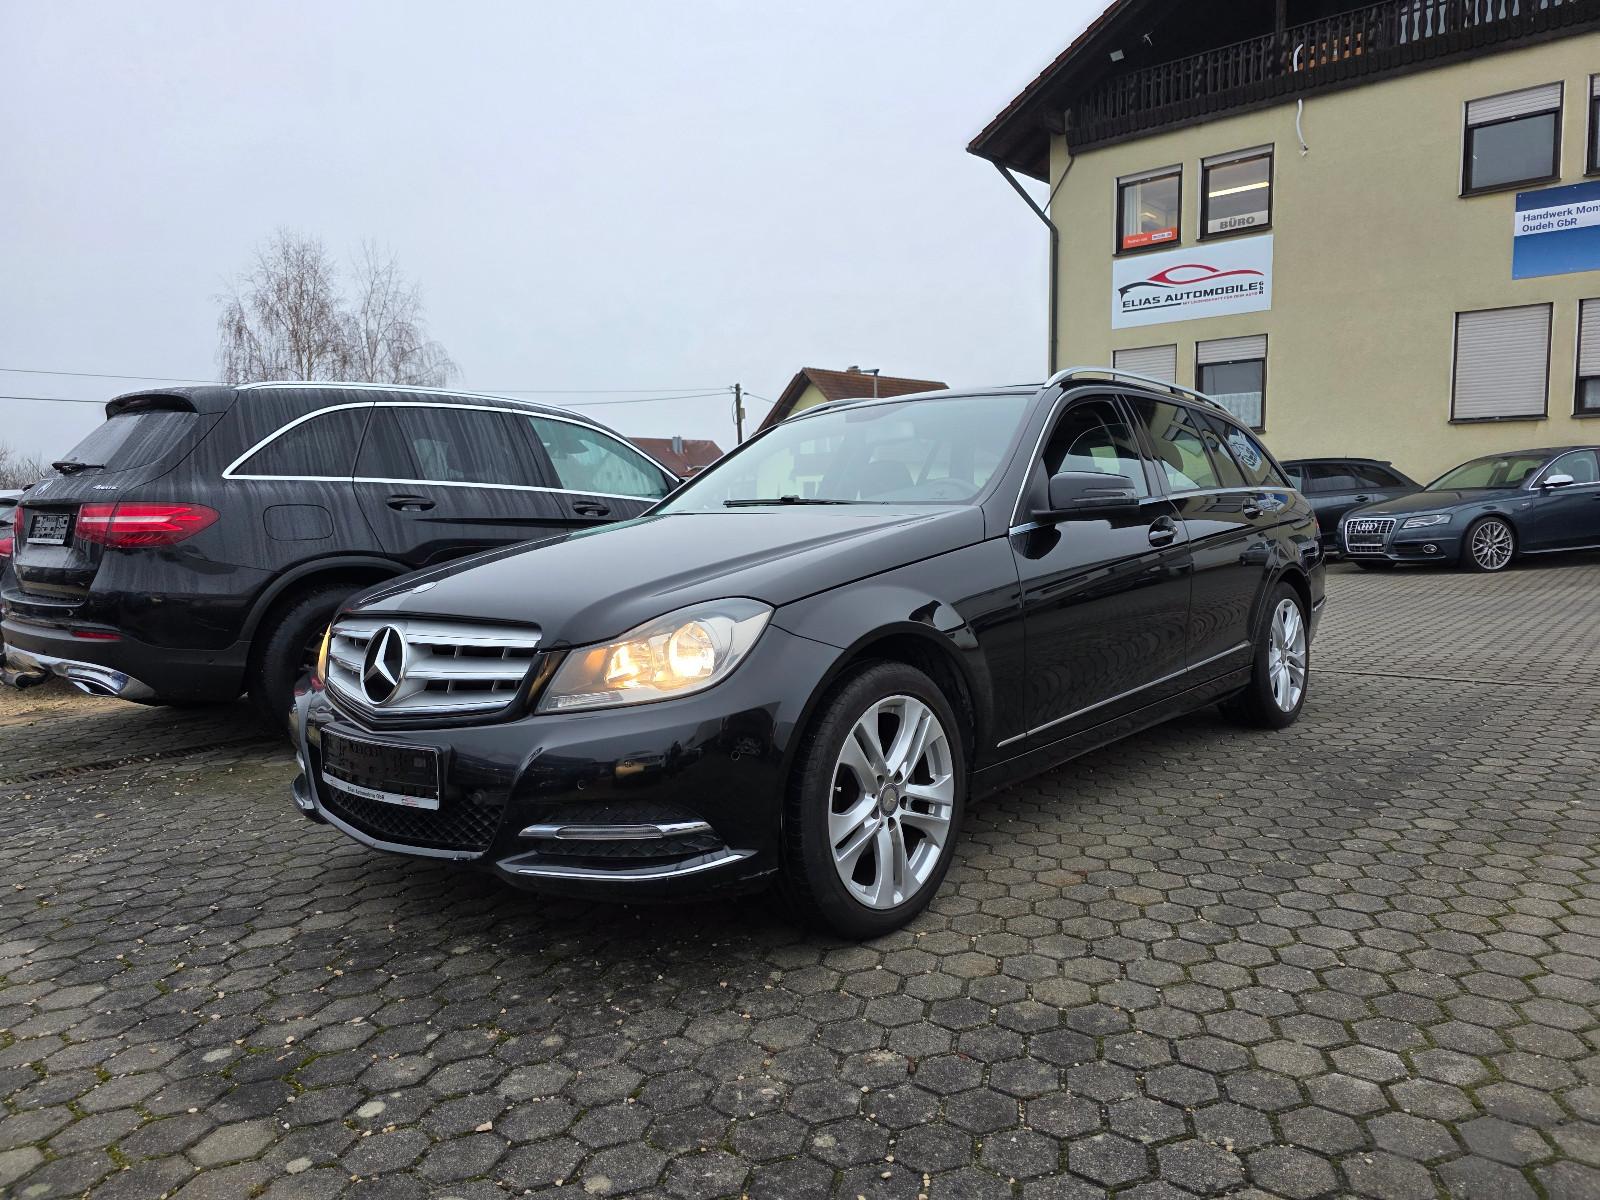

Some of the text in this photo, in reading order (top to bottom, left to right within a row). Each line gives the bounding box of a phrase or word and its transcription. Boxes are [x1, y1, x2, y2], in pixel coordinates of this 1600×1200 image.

[1523, 208, 1573, 222] Handwerk
[1220, 216, 1255, 229] BÜRO
[1522, 217, 1577, 232] Oudeh GbR
[1122, 281, 1258, 308] ELIAS AUTOMOBILE
